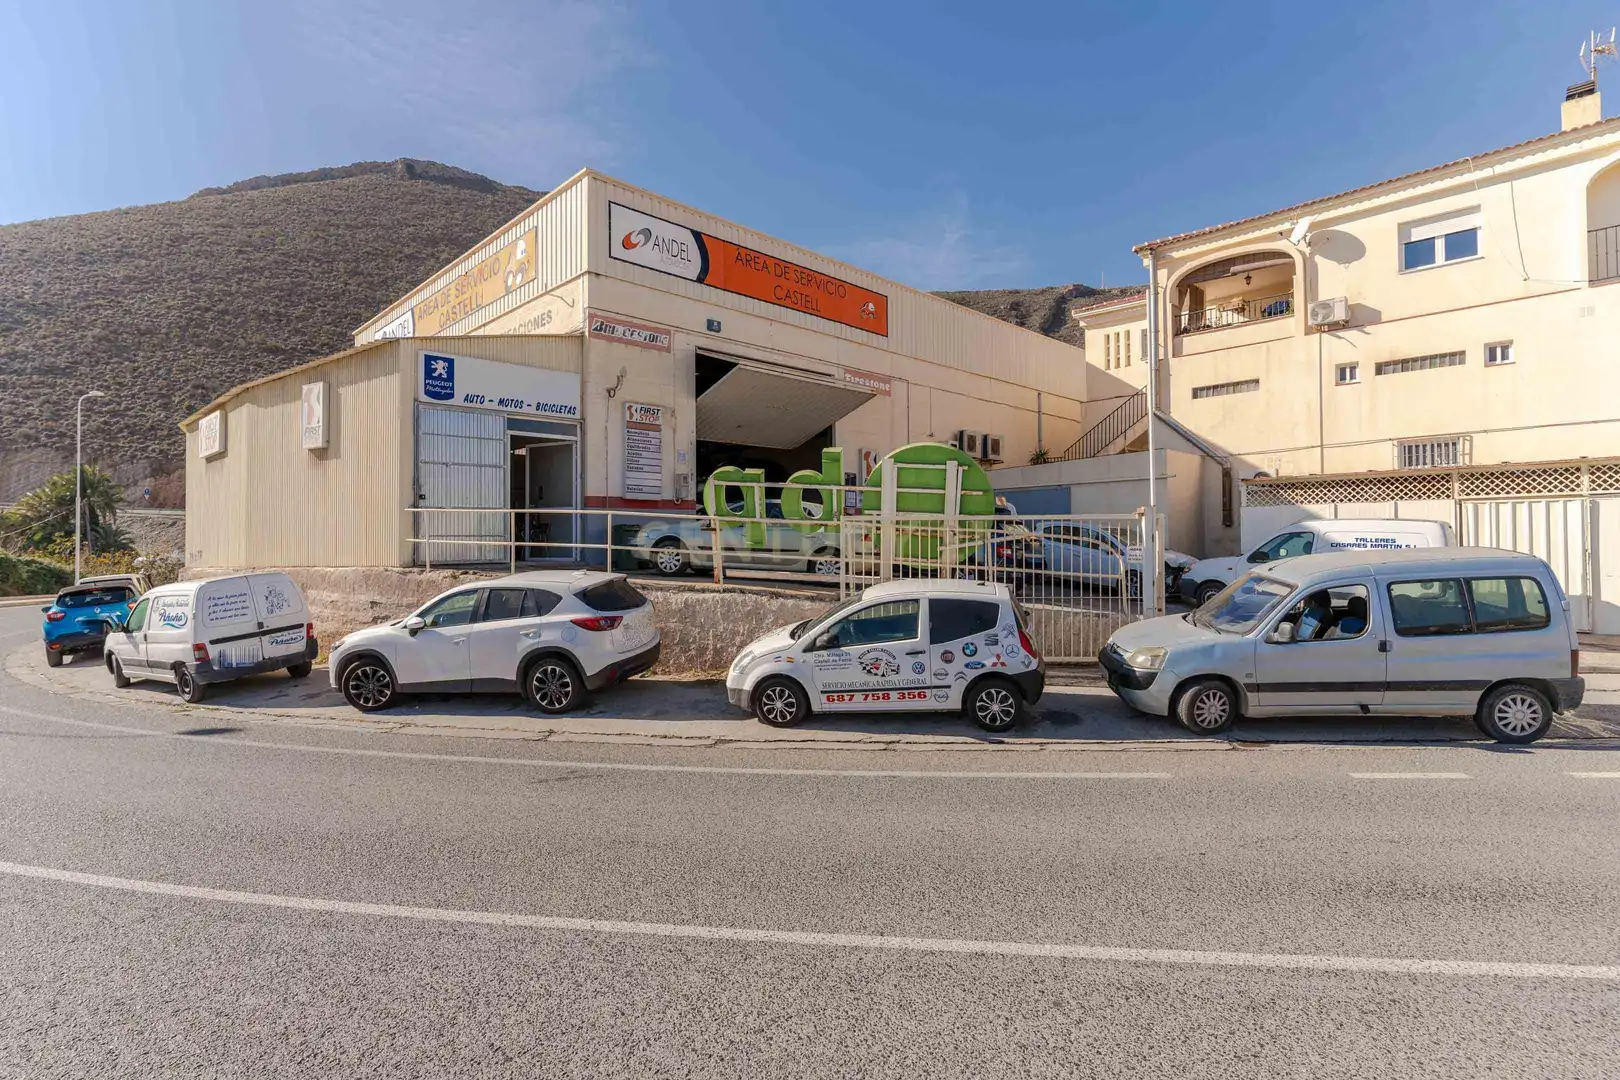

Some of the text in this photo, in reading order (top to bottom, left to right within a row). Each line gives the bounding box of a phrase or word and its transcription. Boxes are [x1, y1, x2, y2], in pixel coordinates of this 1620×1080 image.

[652, 235, 691, 262] ANDEL
[454, 258, 500, 299] SERVICIO
[735, 247, 847, 299] ÁREA DE SERVICIO
[773, 284, 821, 313] CASTELL
[426, 379, 453, 387] PEUGEOT
[845, 373, 890, 391] Firestone
[463, 393, 485, 405] AUTO
[498, 397, 523, 410] MOTOS
[535, 401, 577, 416] BICICLETAS
[640, 407, 661, 415] FIRST
[821, 681, 847, 689] SERVICIO
[902, 677, 928, 686] GENERAL
[826, 694, 855, 703] 687
[861, 692, 891, 702] 758
[896, 690, 928, 700] 356
